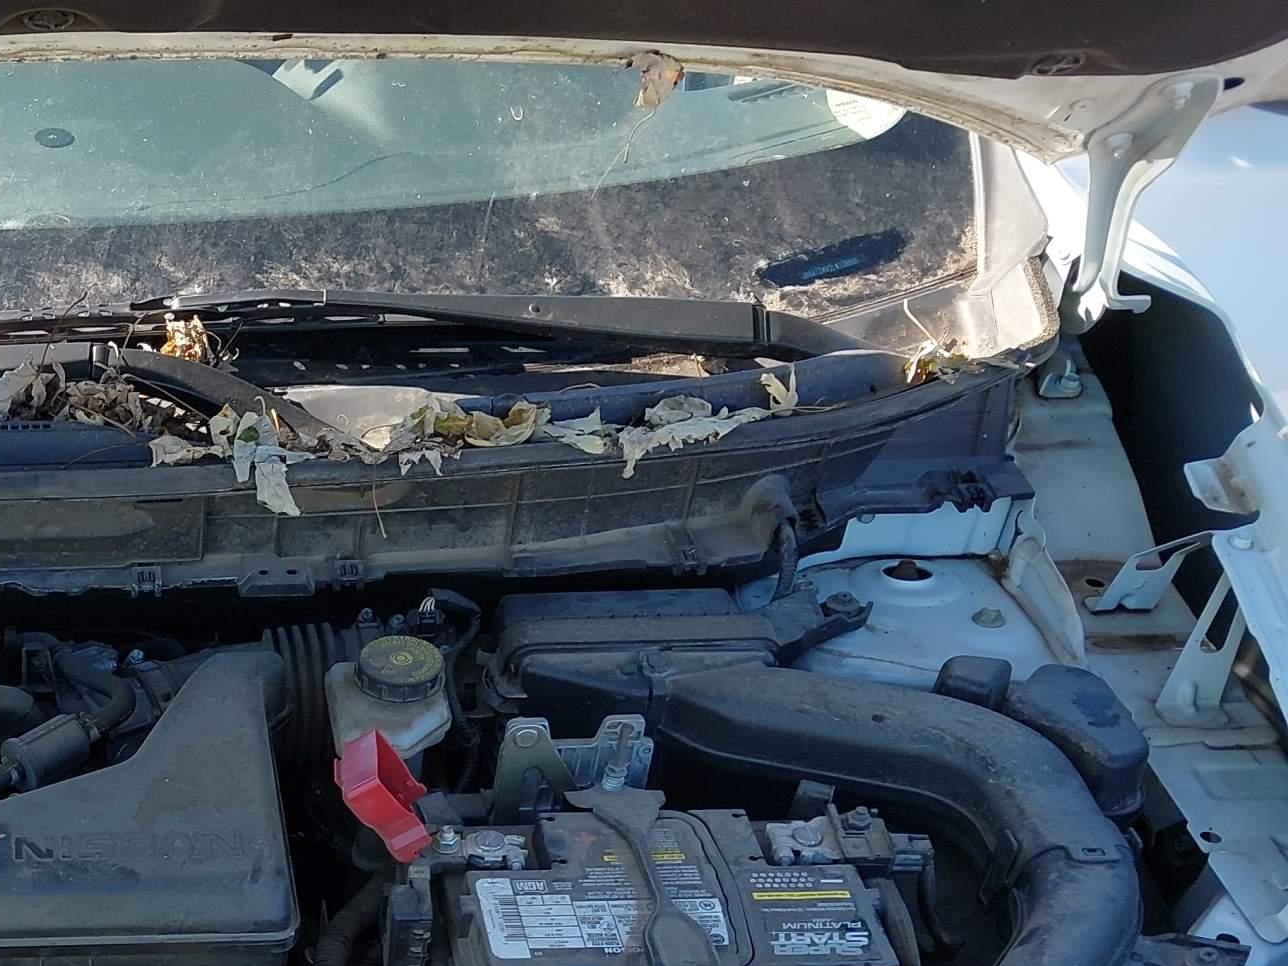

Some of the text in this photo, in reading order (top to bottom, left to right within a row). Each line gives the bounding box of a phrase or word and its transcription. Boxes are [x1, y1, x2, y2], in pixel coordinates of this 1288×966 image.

[516, 880, 546, 893] AGM
[782, 921, 862, 931] PLATINUM
[772, 932, 869, 944] START
[774, 943, 863, 956] SUPER
